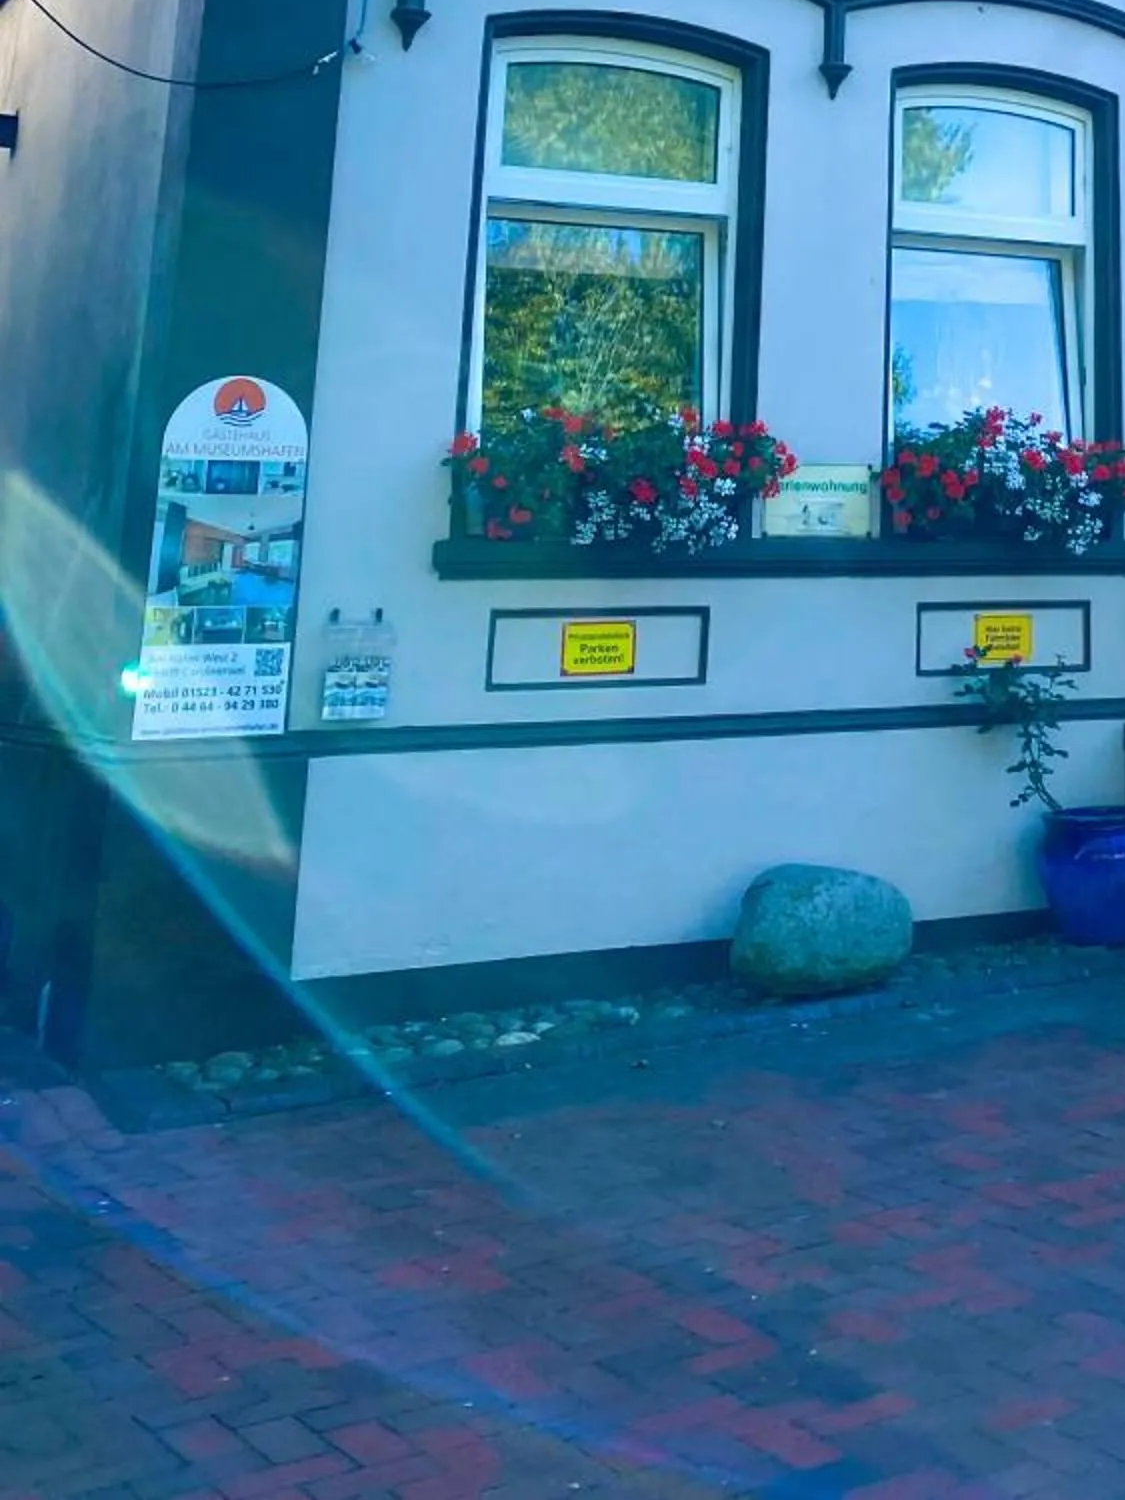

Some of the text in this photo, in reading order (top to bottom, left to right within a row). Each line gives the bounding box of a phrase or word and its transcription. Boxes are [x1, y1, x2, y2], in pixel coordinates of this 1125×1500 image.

[166, 442, 304, 457] AM MUSEUMSHAFEN
[579, 643, 619, 653] Parken
[572, 654, 625, 665] verboten!
[143, 687, 179, 699] Mobil
[226, 685, 241, 697] 42
[243, 685, 257, 696] 71
